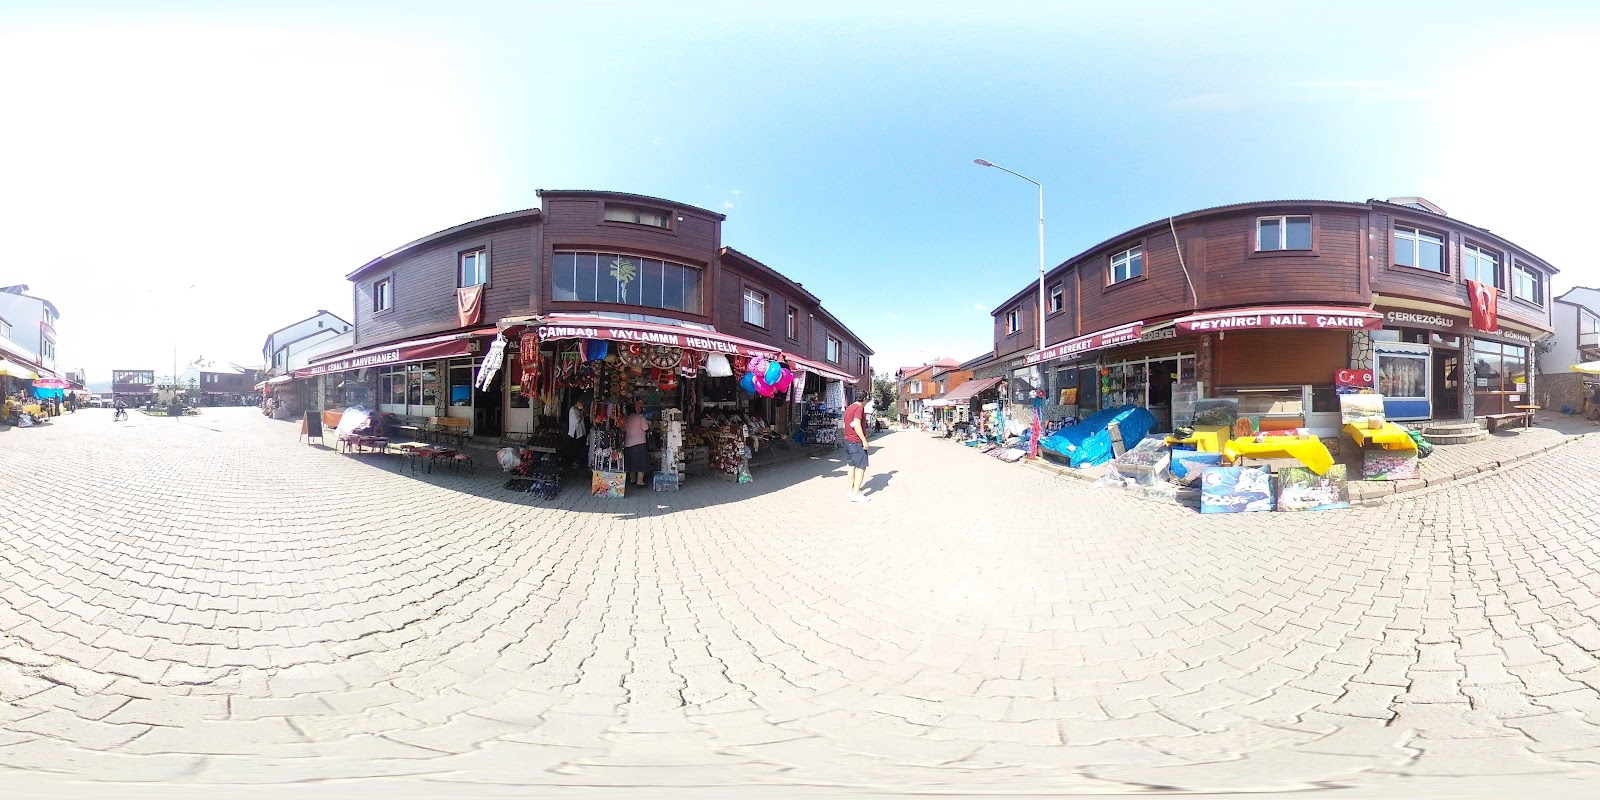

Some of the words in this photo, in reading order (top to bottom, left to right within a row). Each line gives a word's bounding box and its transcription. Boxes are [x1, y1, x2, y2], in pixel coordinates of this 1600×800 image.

[1191, 315, 1261, 330] PEYNİRCİ
[1270, 314, 1307, 325] NAİL
[1317, 316, 1363, 327] ÇAKIR
[1387, 311, 1454, 327] ÇERKEZOĞLU
[538, 326, 598, 339] ÇAMBAŞI
[609, 329, 679, 345] YAYLAMMM
[686, 337, 739, 353] HEDİYELİK
[1503, 331, 1530, 342] GÖKHAN
[351, 349, 400, 367] KAHVEHANESİ
[1042, 350, 1056, 360] GIDA
[1059, 340, 1093, 355] BEREKET
